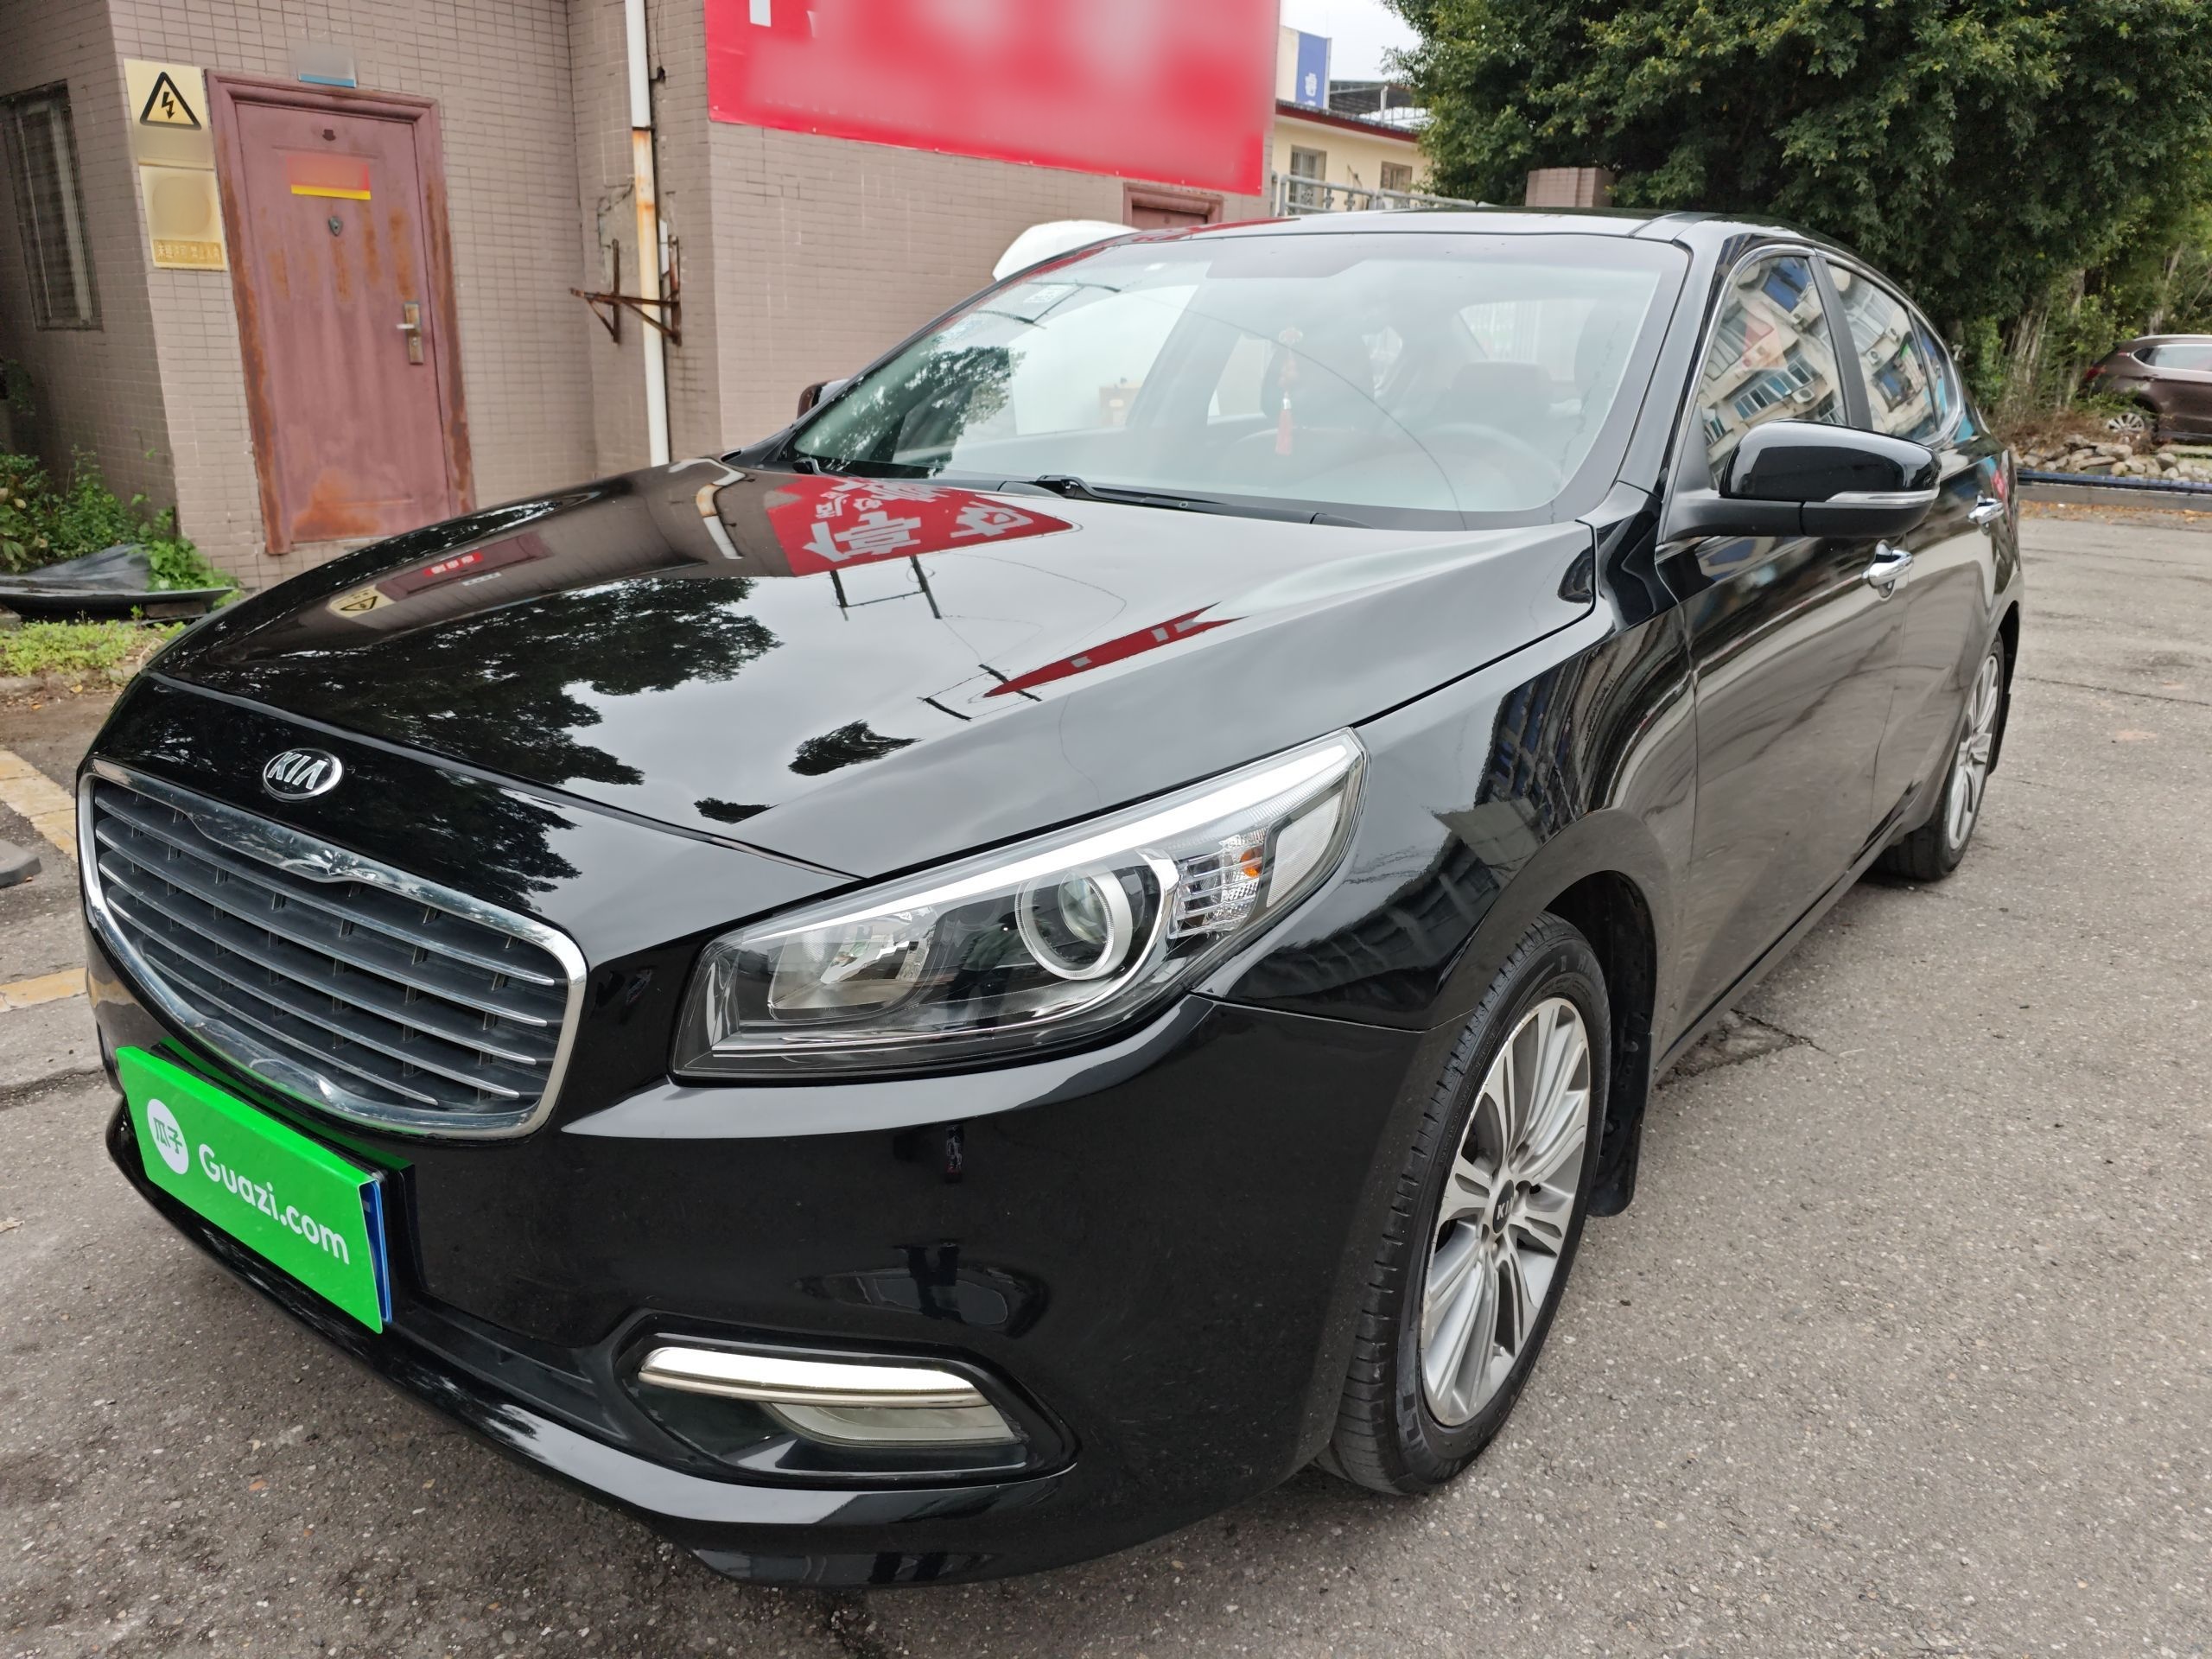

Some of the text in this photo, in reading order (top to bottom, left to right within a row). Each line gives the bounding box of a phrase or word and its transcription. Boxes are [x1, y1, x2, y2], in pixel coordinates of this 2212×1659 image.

[267, 752, 327, 790] KIA
[153, 1117, 182, 1154] 瓜子
[199, 1144, 350, 1264] Guazi.com
